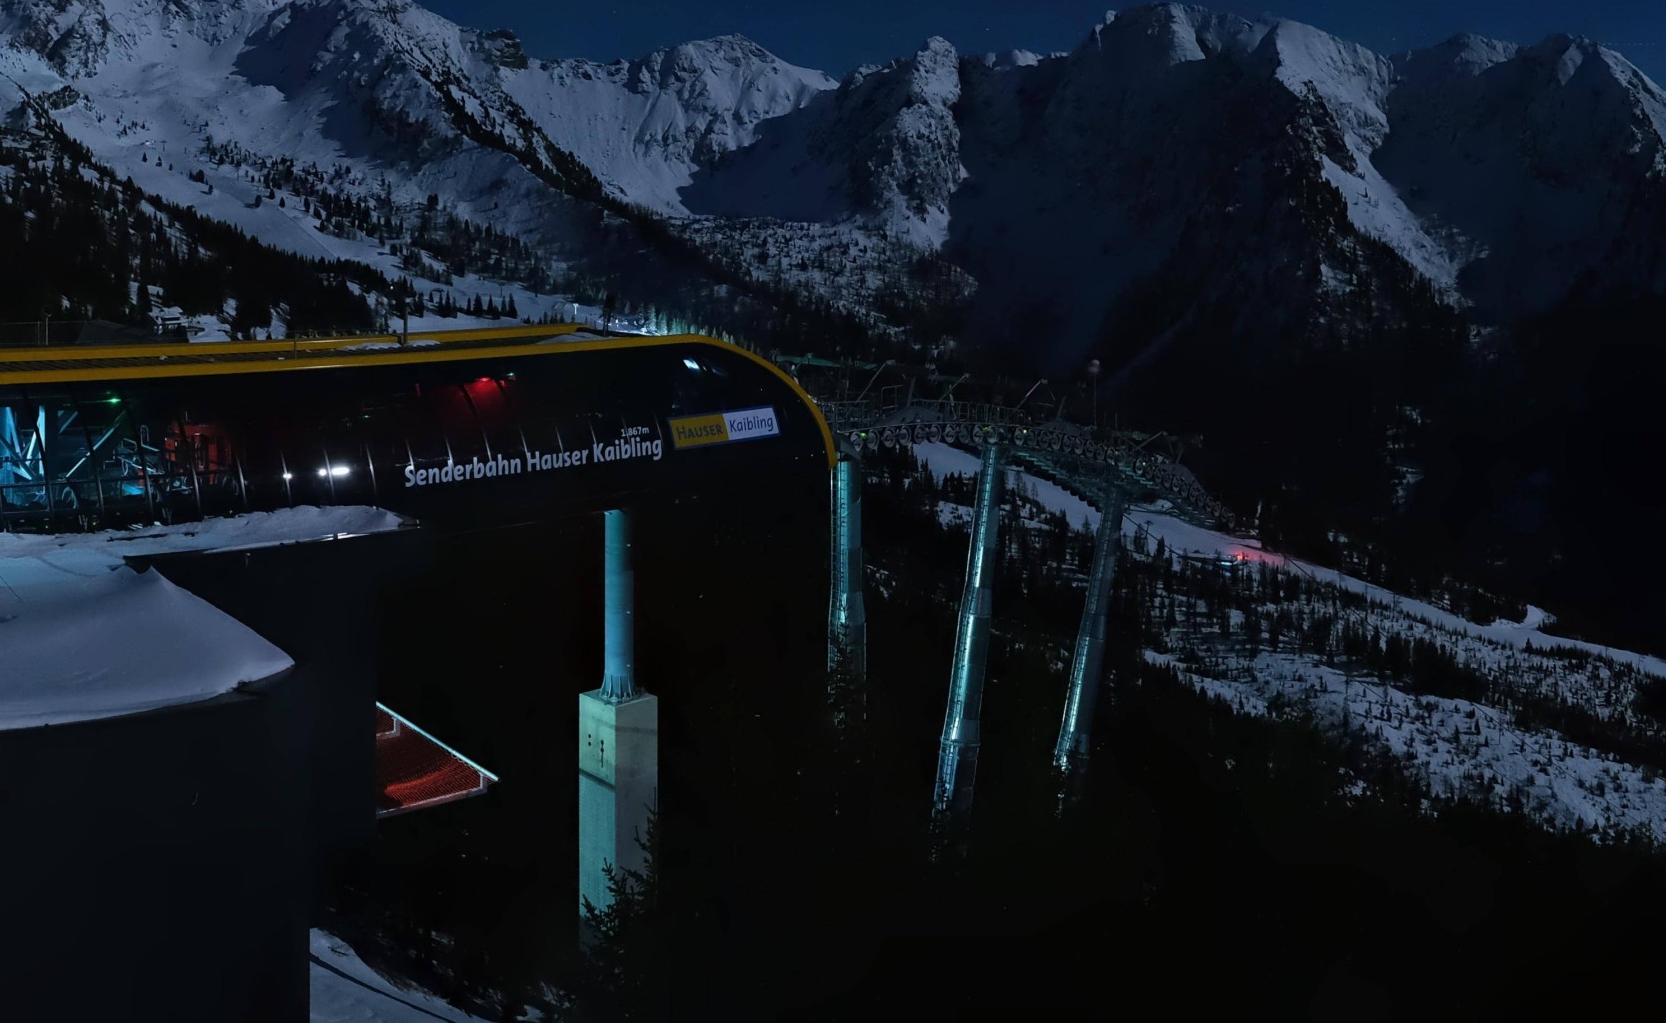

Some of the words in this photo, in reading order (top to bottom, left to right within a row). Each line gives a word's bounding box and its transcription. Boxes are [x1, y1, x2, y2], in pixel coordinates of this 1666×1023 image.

[621, 426, 650, 437] 1.867m
[676, 424, 723, 441] HAUSER
[729, 416, 774, 432] Kaibling
[404, 452, 521, 488] Senderbahn
[527, 446, 590, 472] Hauser
[593, 437, 663, 463] Kaibling
